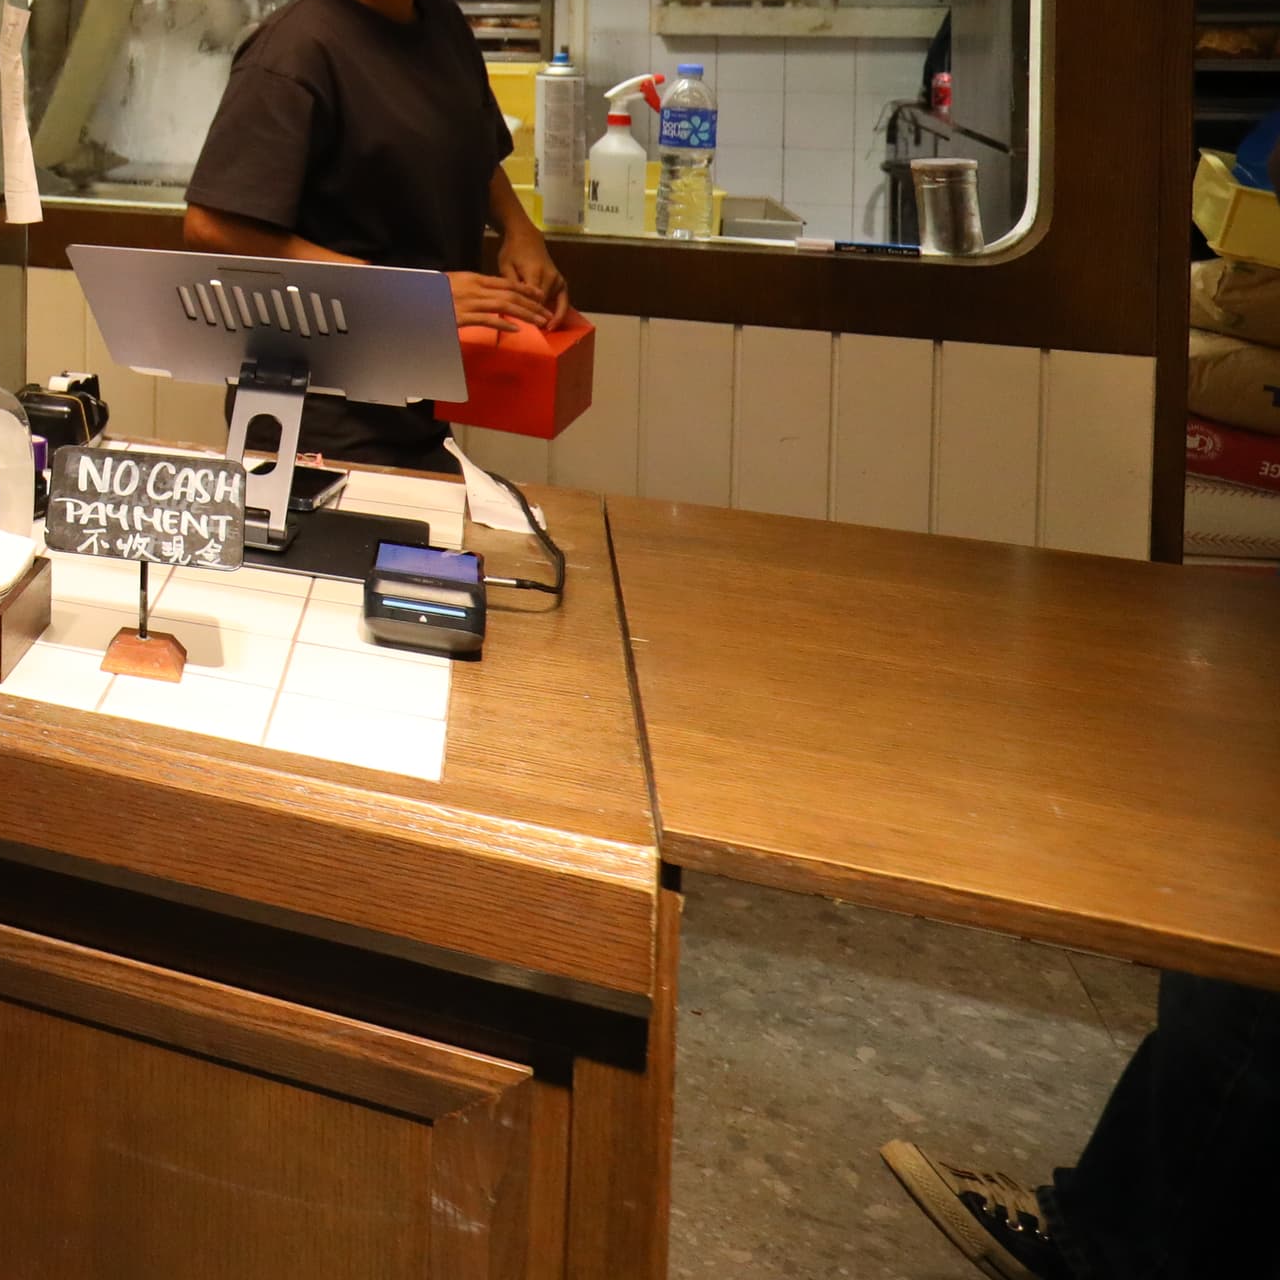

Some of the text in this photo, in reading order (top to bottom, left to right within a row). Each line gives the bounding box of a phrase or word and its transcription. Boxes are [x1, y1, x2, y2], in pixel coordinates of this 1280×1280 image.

[78, 456, 241, 507] NO CASH
[53, 497, 233, 541] PAYMENT
[77, 528, 234, 569] 不收現金
